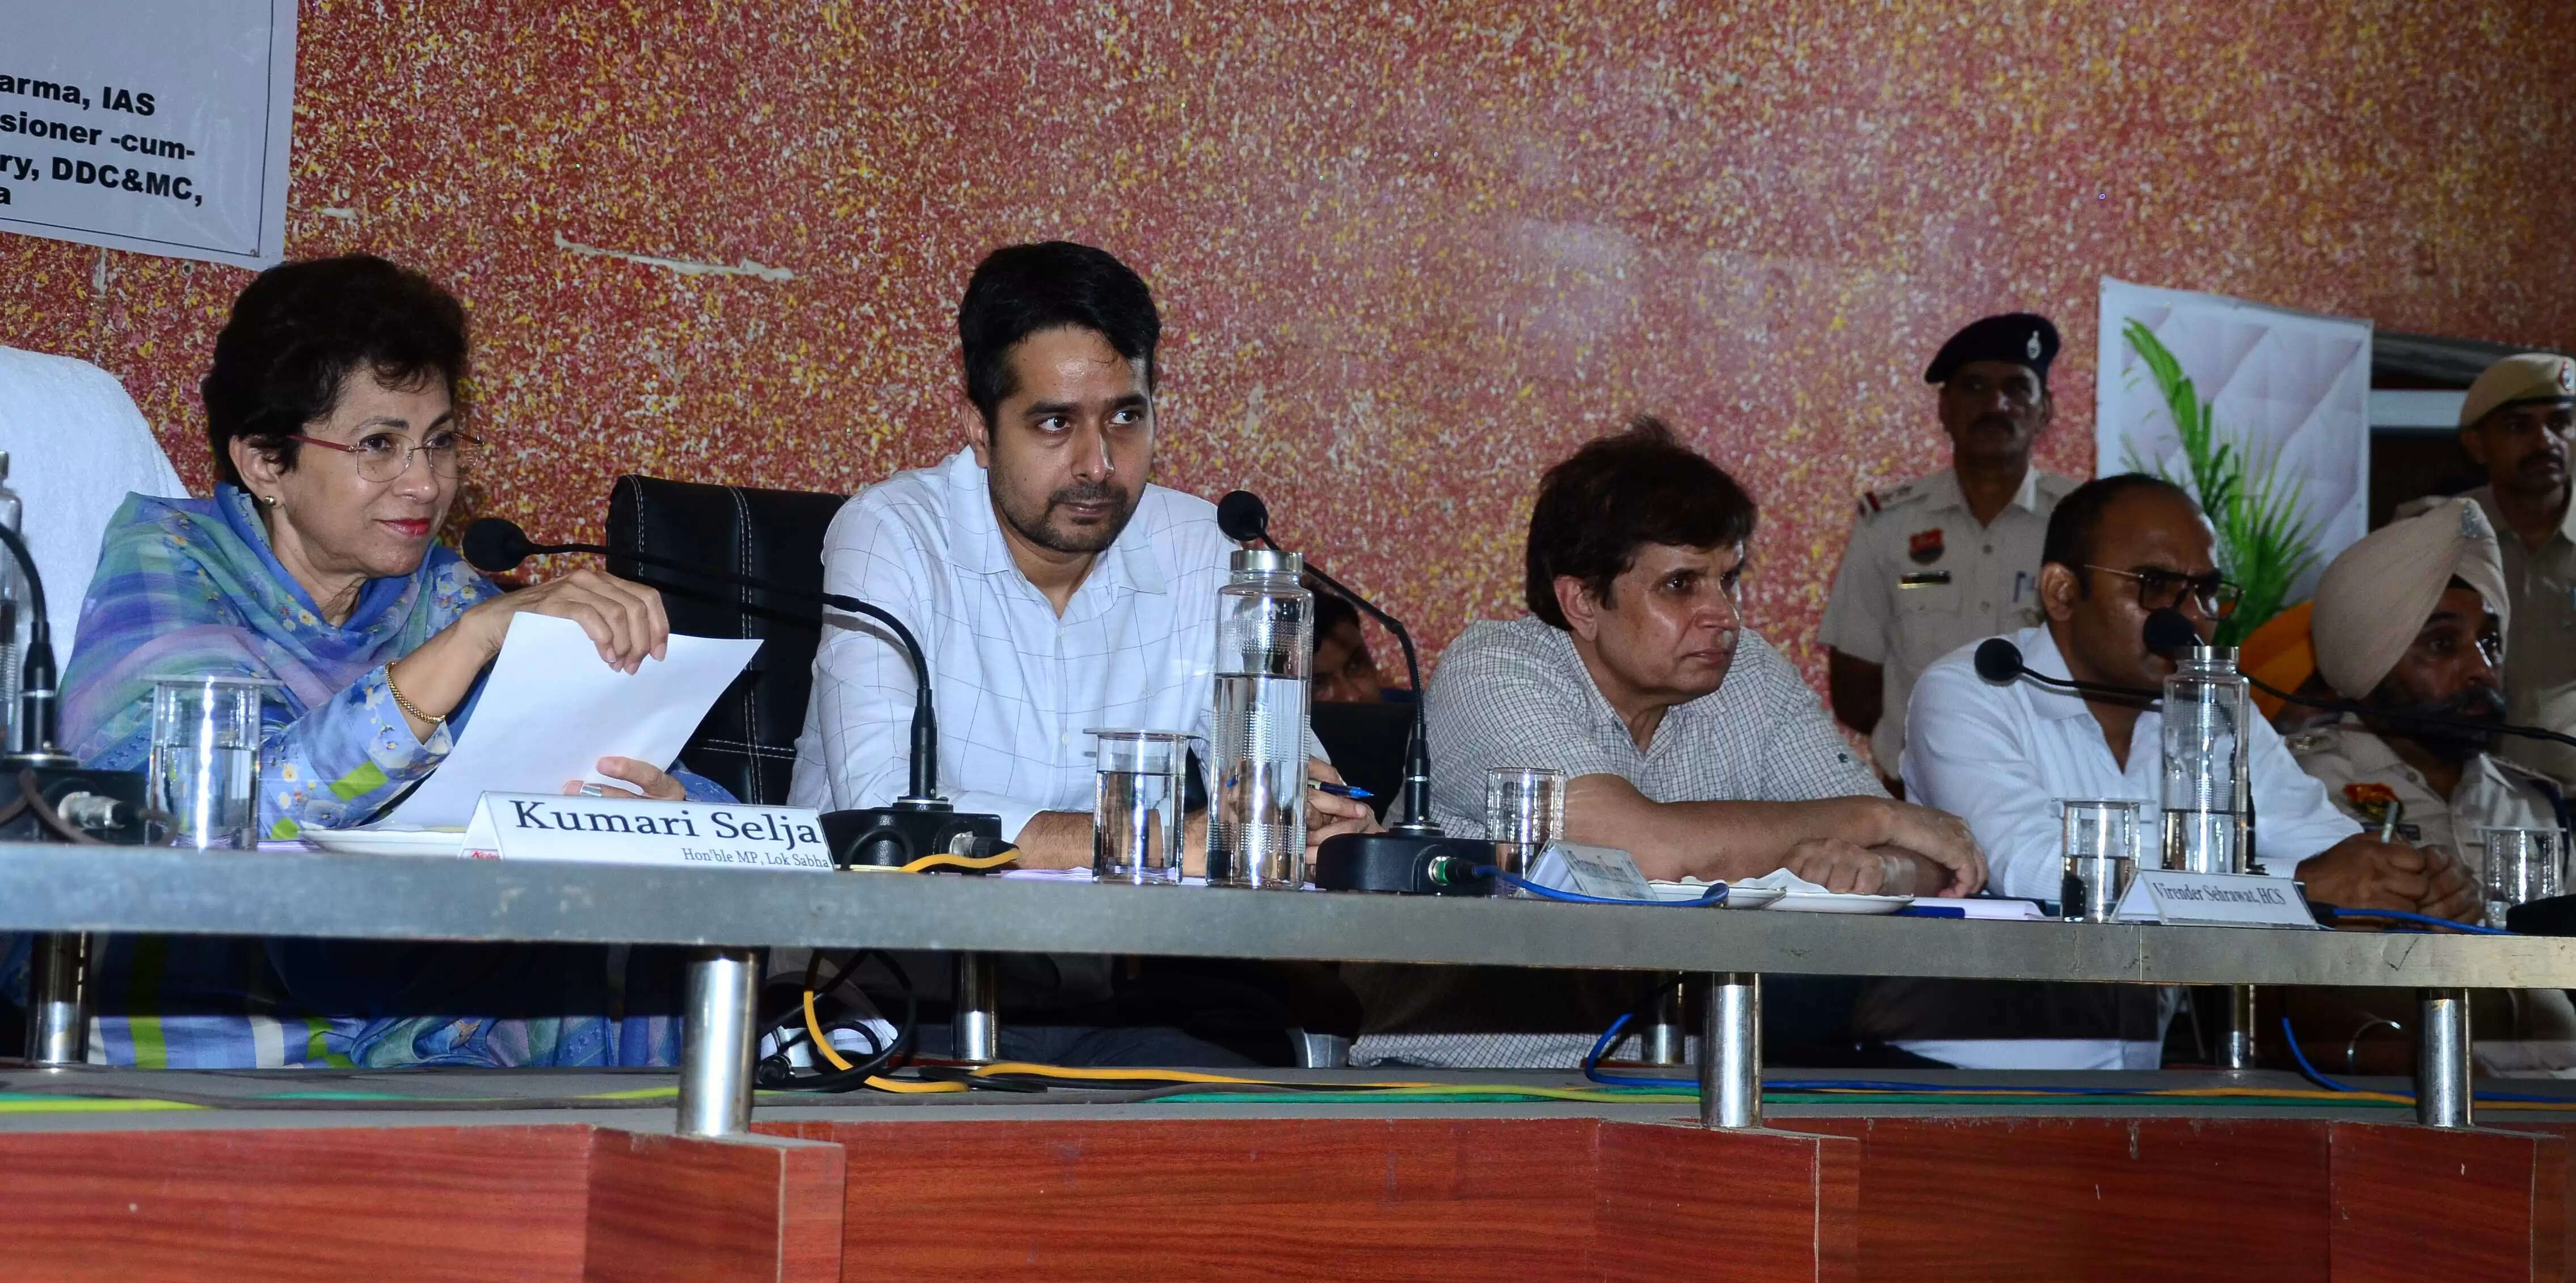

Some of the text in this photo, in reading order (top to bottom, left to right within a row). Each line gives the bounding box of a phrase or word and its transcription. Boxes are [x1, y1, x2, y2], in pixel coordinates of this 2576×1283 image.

[0, 74, 155, 116] arma, IAS
[0, 111, 196, 160] sioner -cum-
[0, 154, 203, 207] ry, DDC&MC,
[510, 800, 822, 850] Kumari Selja
[681, 847, 733, 863] Hon'ble
[765, 852, 791, 866] Lok
[792, 854, 830, 868] Sabha
[2152, 883, 2204, 901] Virender
[2256, 887, 2286, 905] HCS
